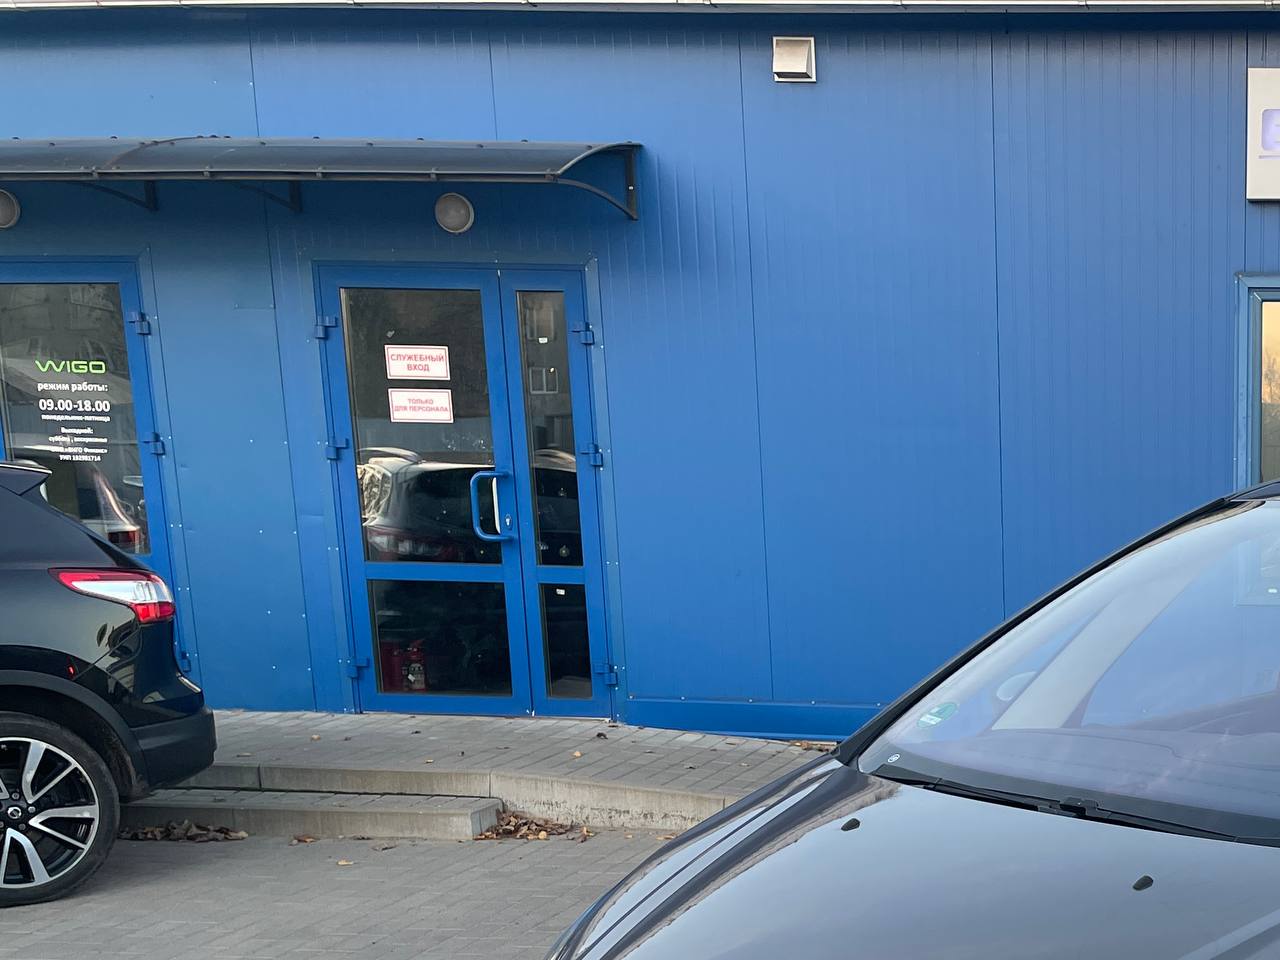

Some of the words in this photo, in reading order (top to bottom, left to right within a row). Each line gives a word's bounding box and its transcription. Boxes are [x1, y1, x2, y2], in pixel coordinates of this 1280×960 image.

[390, 353, 444, 362] СЛУЖЕБНЫЙ
[35, 360, 106, 374] WIGO
[406, 363, 430, 372] ВХОД
[37, 382, 70, 392] режим
[71, 381, 109, 393] работы:
[38, 398, 111, 412] 09.00-18.00
